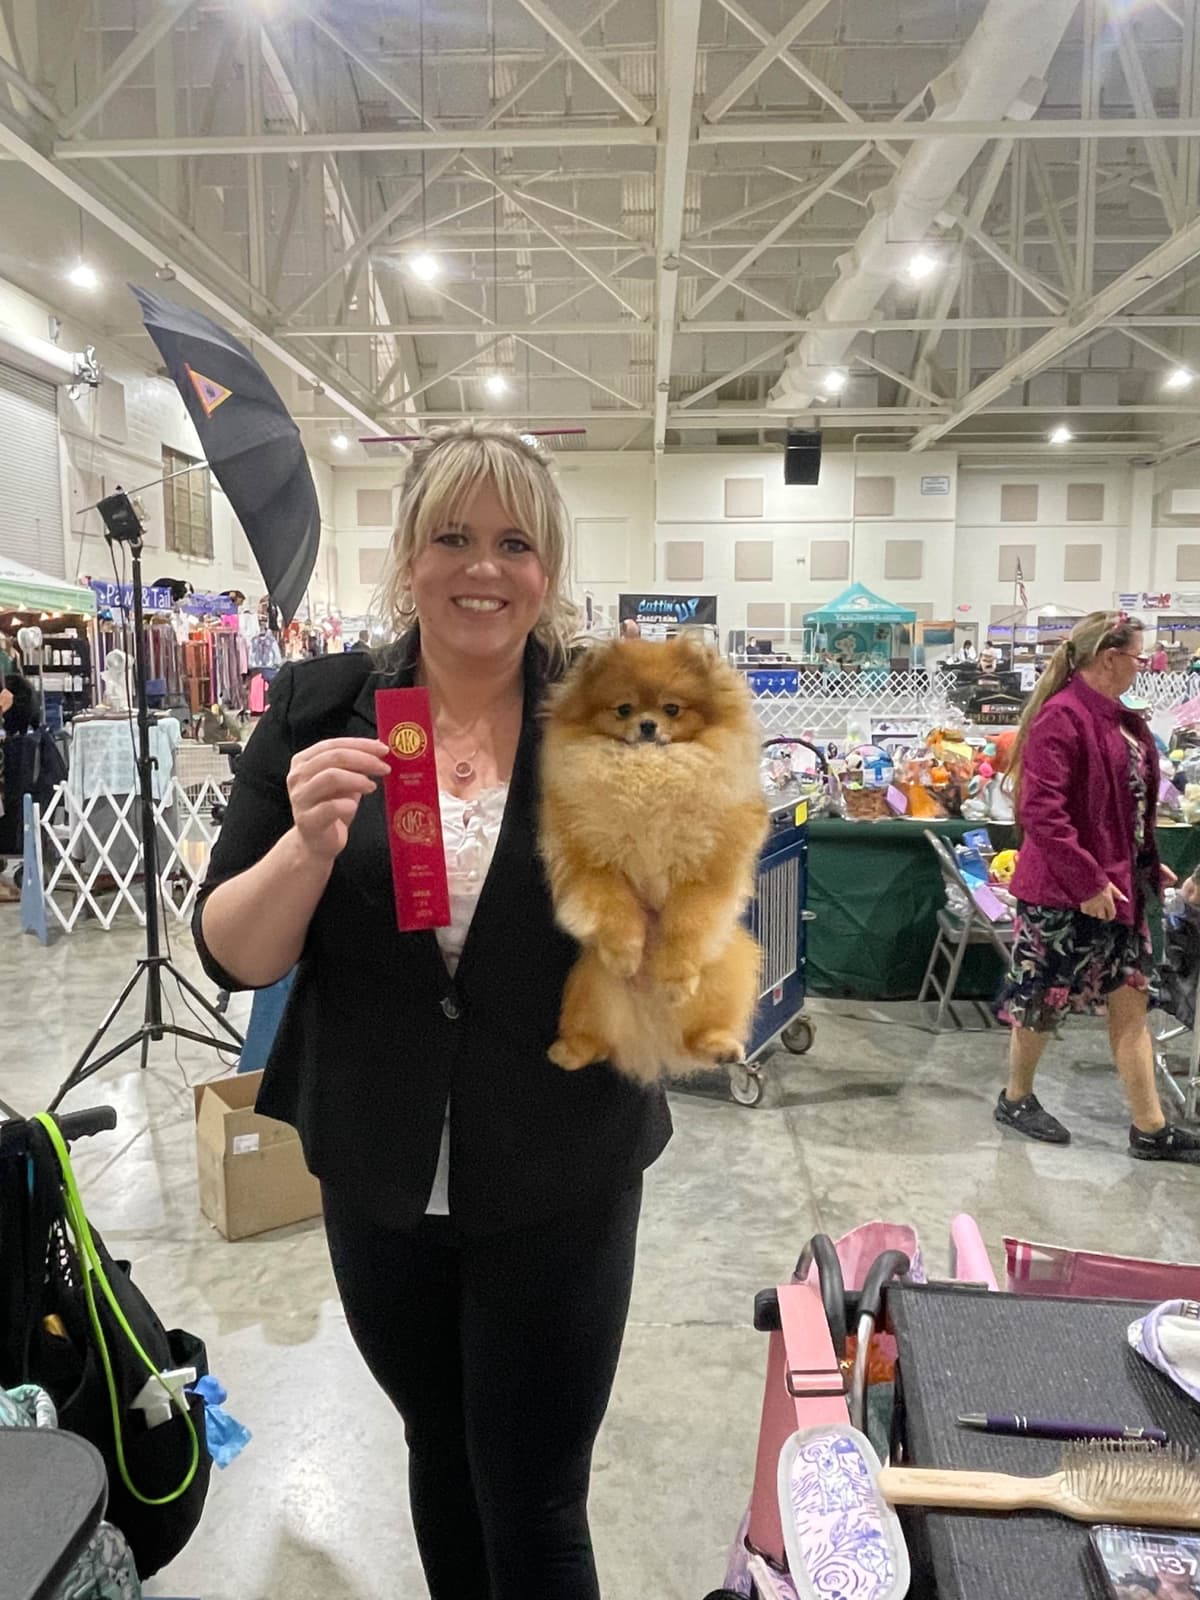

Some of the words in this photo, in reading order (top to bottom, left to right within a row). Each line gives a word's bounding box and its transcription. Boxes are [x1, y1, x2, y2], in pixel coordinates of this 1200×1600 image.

[142, 588, 150, 607] &
[767, 678, 773, 686] 2
[780, 678, 786, 686] 3
[395, 729, 420, 753] AKC
[1131, 1553, 1198, 1576] 11:37
